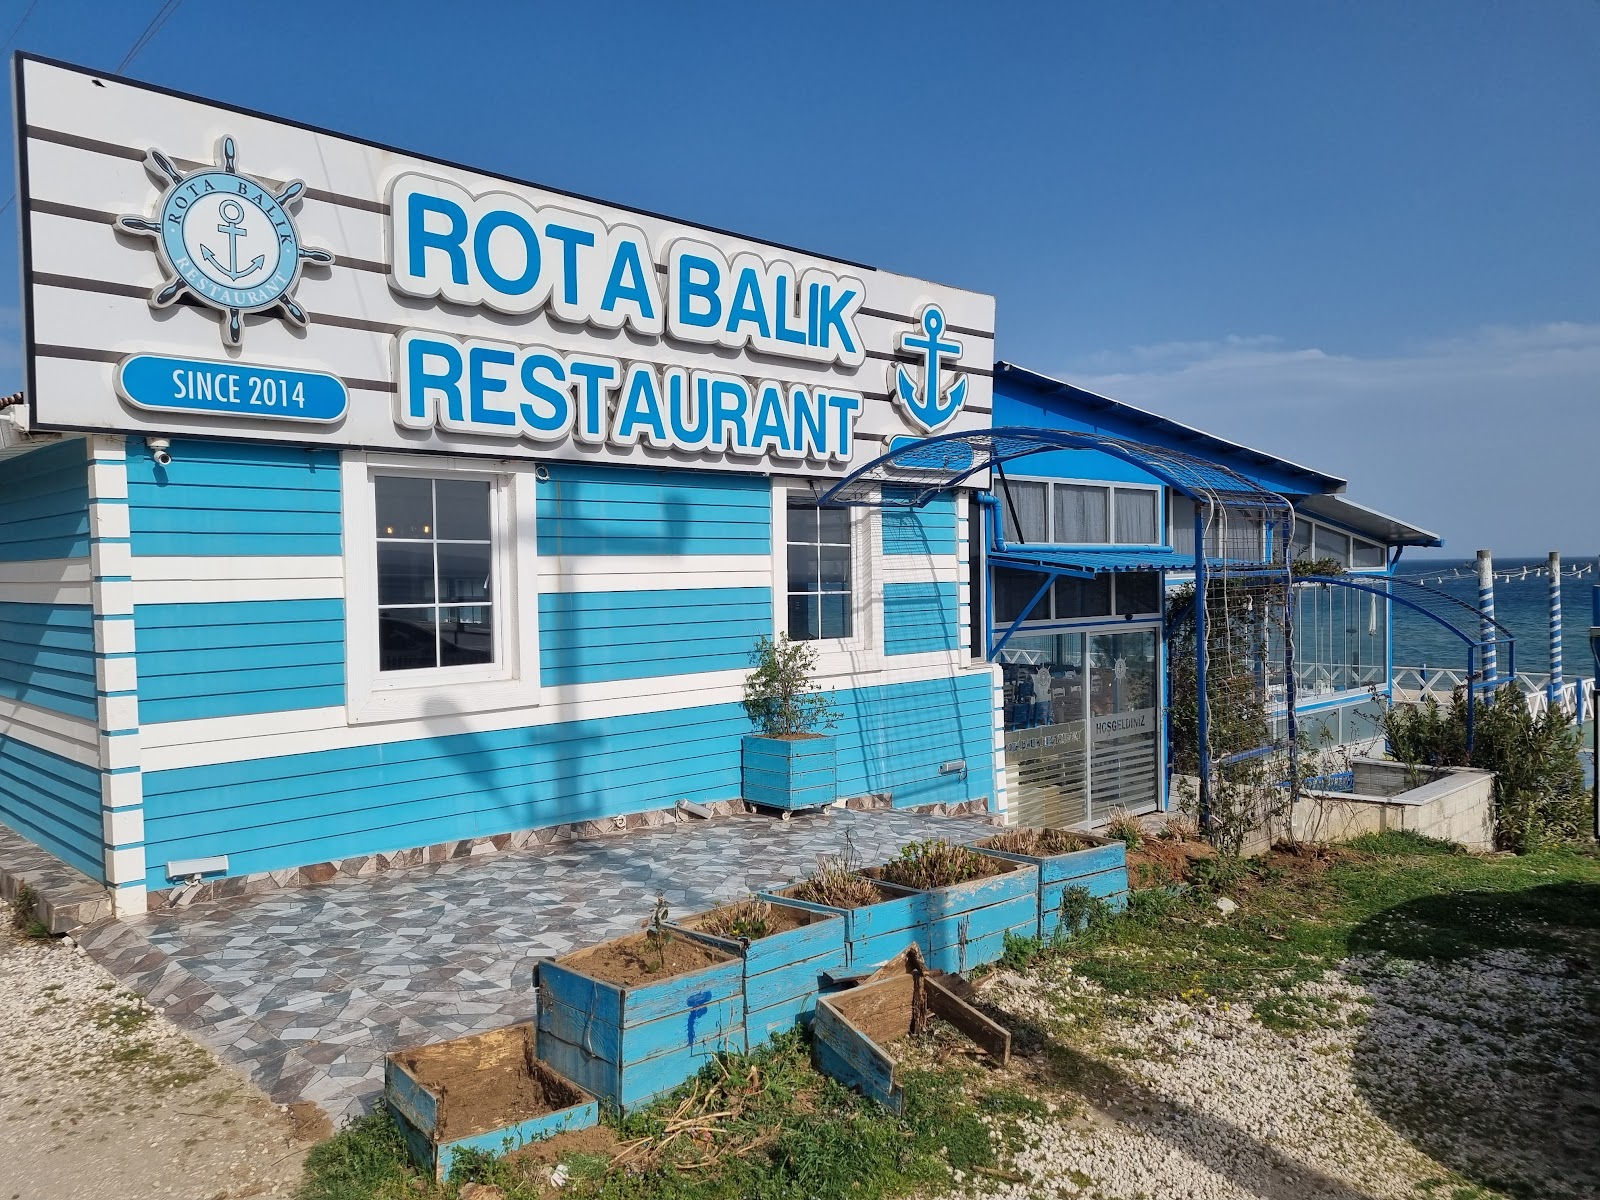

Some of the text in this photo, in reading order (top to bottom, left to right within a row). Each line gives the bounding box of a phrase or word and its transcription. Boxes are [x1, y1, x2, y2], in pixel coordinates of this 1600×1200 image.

[168, 179, 293, 245] ROTA BALIK
[176, 256, 287, 305] RESTAURANT
[408, 191, 857, 353] ROTA BALIK
[172, 369, 306, 408] SINCE 2014
[408, 339, 859, 456] RESTAURANT
